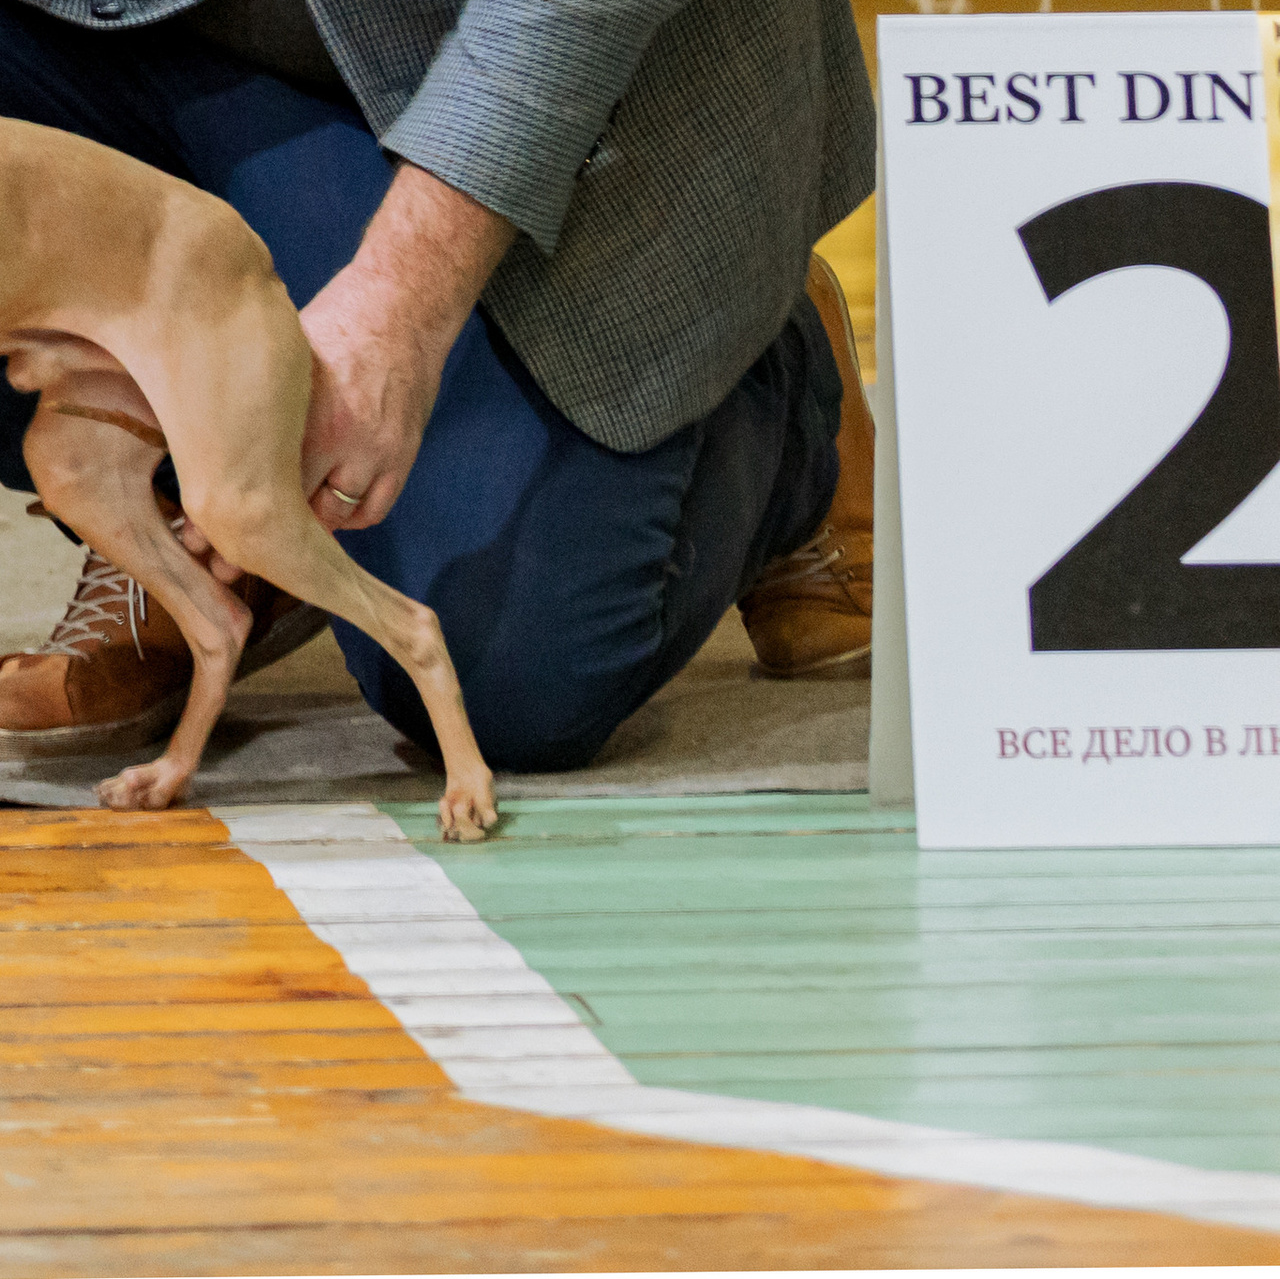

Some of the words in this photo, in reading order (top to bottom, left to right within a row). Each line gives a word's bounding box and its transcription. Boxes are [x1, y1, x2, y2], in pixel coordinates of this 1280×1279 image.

[903, 71, 1096, 125] BEST
[1116, 70, 1265, 124] DIN
[1015, 179, 1280, 653] 2
[995, 726, 1073, 759] ВСЕ
[1081, 725, 1193, 765] ДЕЛО
[1202, 725, 1228, 757] В
